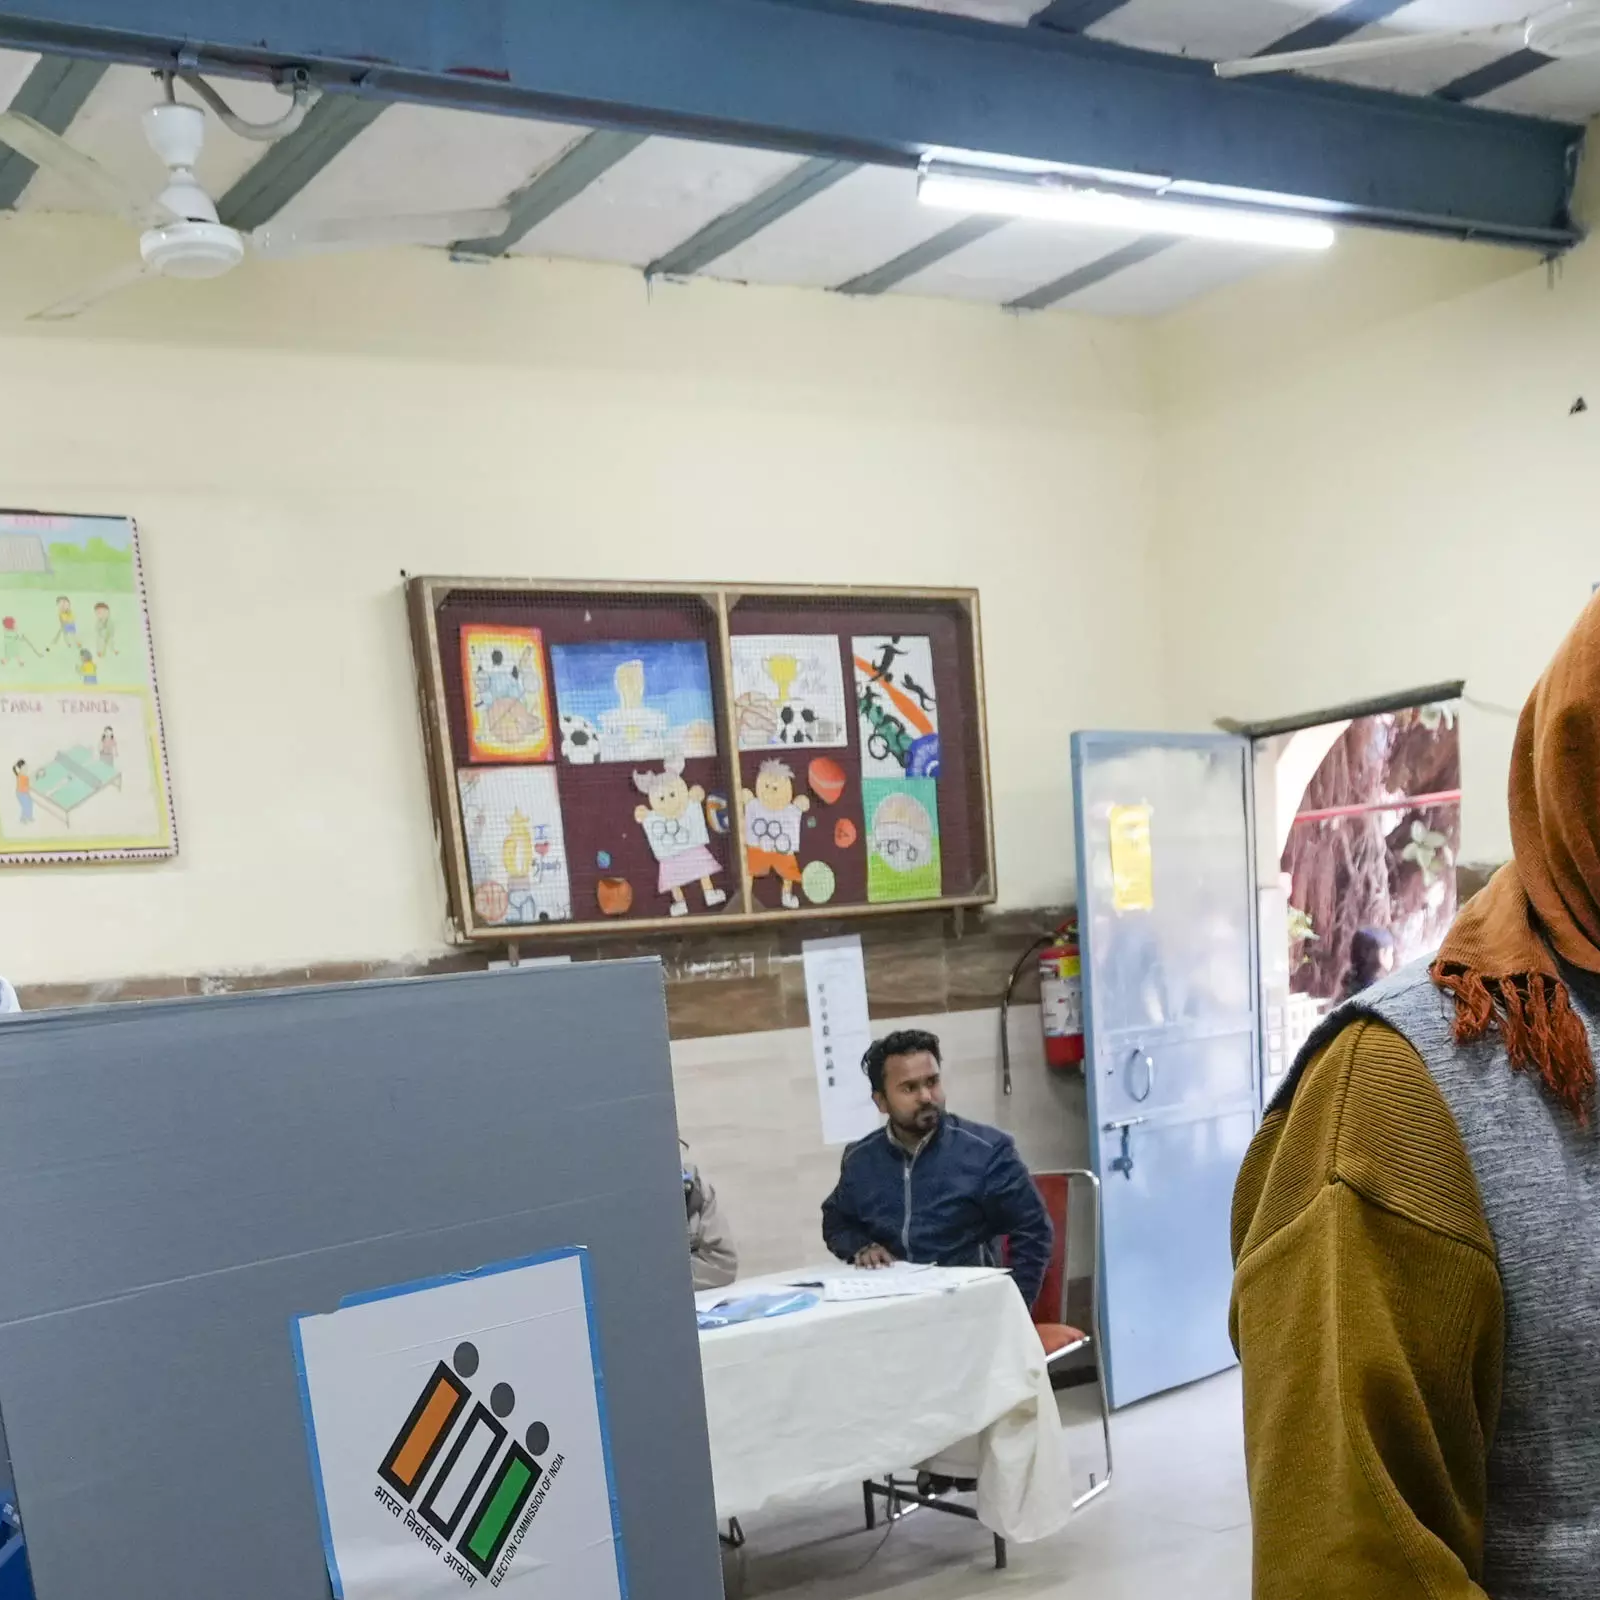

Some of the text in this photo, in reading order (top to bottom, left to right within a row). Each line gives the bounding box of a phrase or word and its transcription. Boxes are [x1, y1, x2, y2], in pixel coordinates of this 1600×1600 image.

[0, 700, 44, 713] TABLE
[374, 1485, 479, 1589] भारत निर्वाचन आयोग
[490, 1452, 567, 1589] ELECTION COMMISSION OF INDIA
